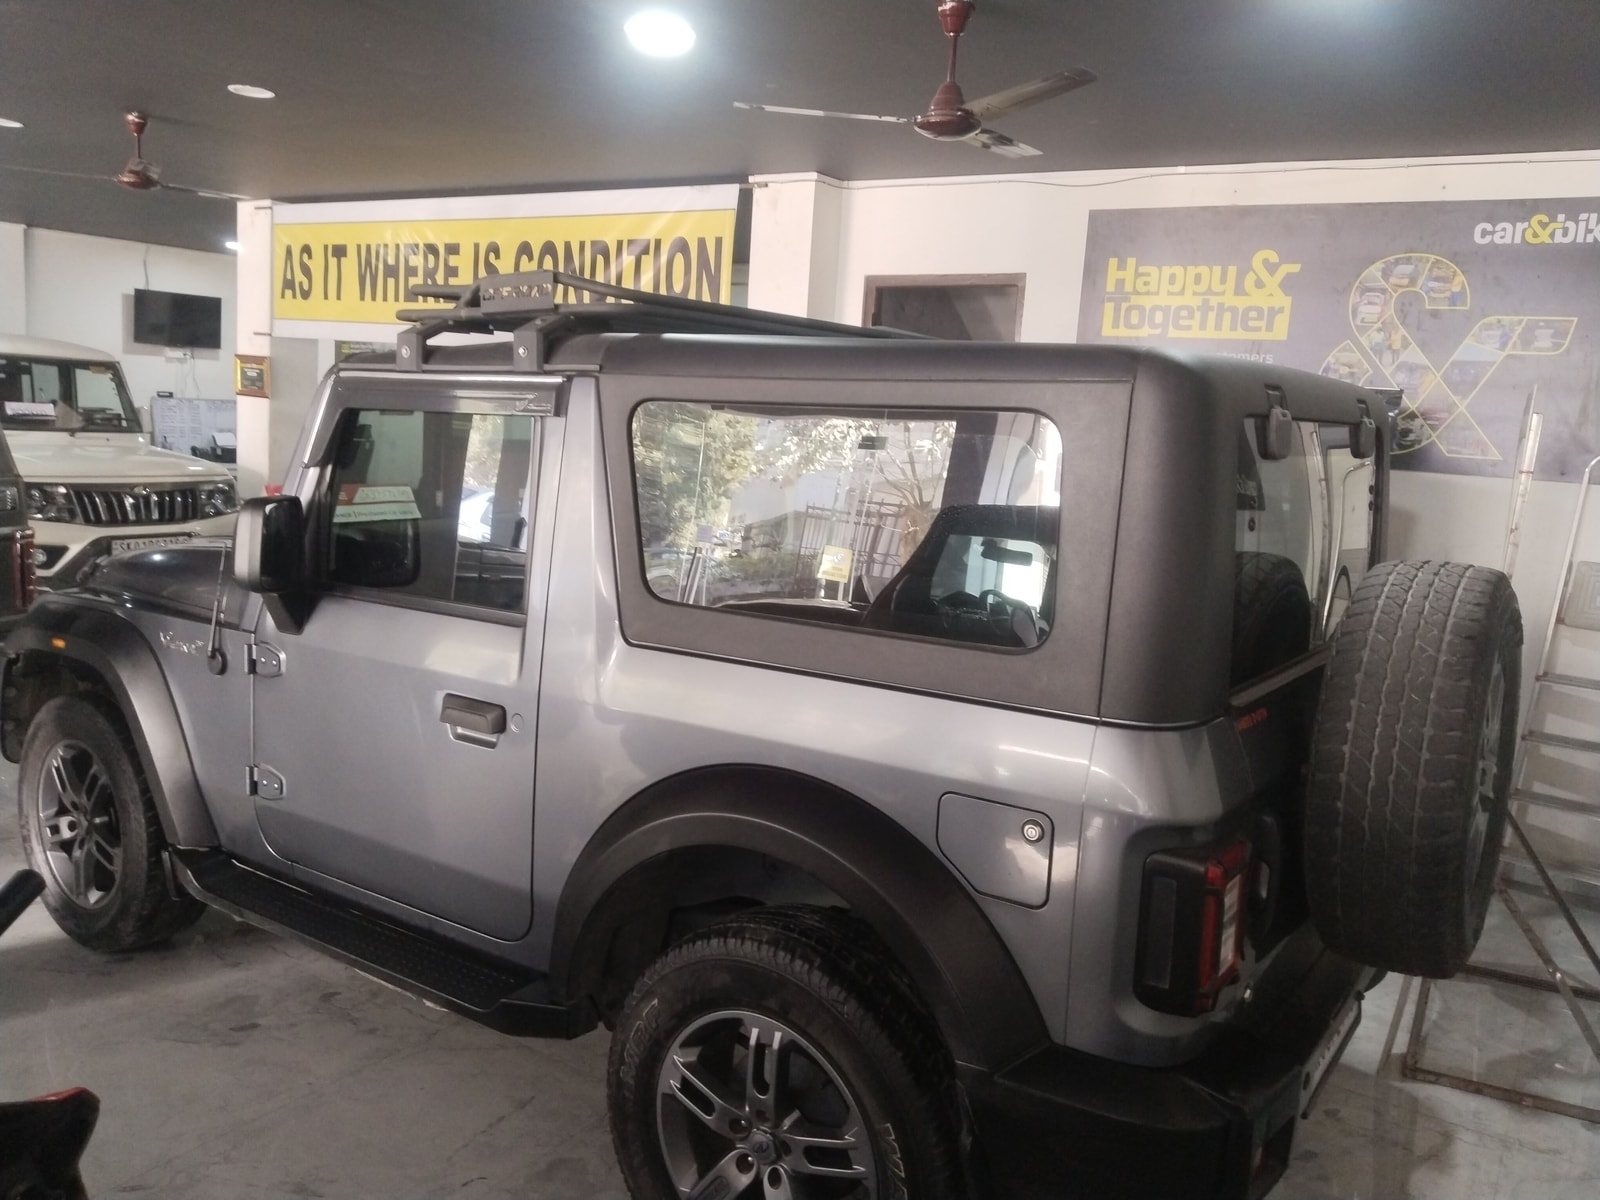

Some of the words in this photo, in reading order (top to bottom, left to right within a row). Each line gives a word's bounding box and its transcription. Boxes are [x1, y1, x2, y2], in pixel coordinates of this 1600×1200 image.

[281, 243, 313, 300] AS
[323, 243, 348, 301] IT
[356, 242, 461, 303] WHERE
[472, 241, 501, 286] IS
[513, 236, 723, 306] CONDITION
[1105, 257, 1237, 297] Happy
[1244, 249, 1302, 297] &
[1104, 296, 1285, 336] Together
